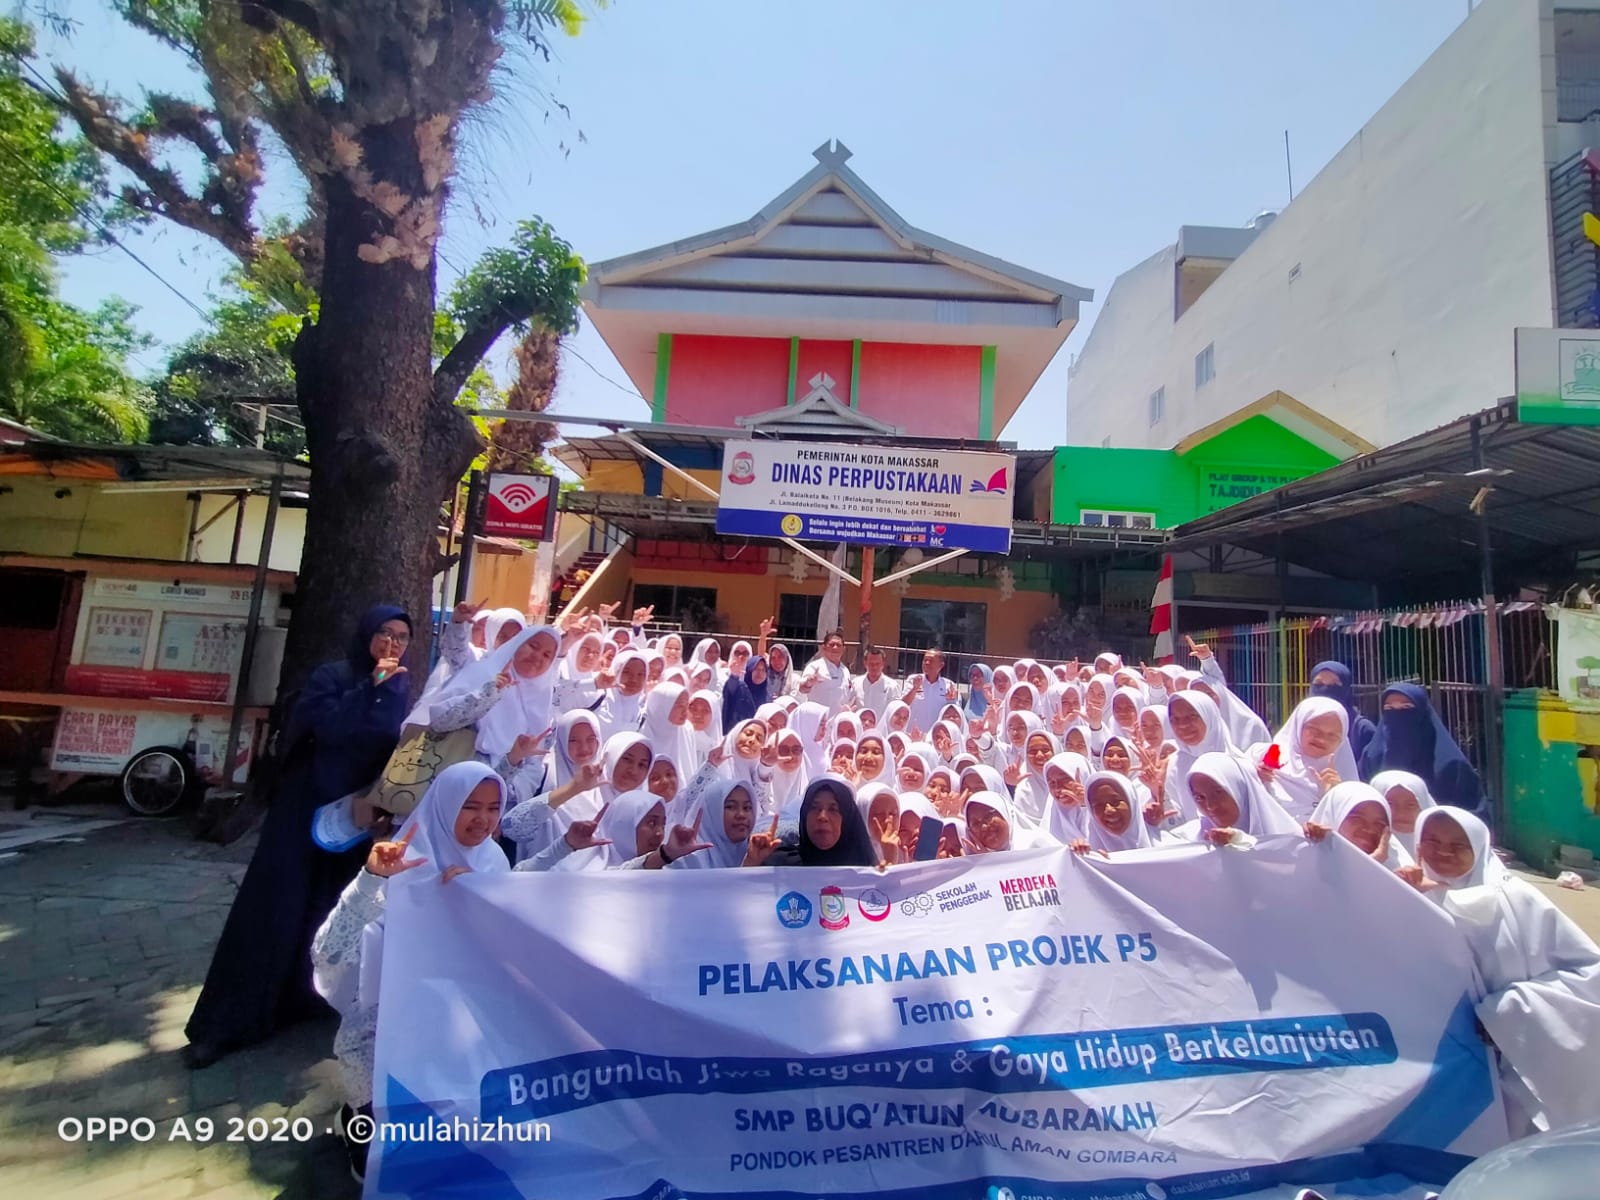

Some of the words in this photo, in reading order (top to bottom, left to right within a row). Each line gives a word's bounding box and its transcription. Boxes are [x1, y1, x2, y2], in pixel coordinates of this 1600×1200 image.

[797, 449, 858, 464] PEMERINTAH
[860, 454, 885, 466] KOTA
[887, 456, 940, 468] MAKASSAR
[771, 462, 823, 486] DINAS
[828, 466, 963, 495] PERPUSTAKAAN
[905, 499, 920, 507] Kota
[809, 527, 835, 536] Bersama
[866, 531, 896, 540] Makassar
[64, 711, 95, 726] CARA
[935, 881, 978, 902] SEKOLAH
[999, 873, 1057, 895] MERDEKA
[939, 889, 993, 913] PENGGERAK
[1003, 888, 1062, 913] BELAJAR
[698, 945, 977, 996] PELAKSANAAN
[984, 935, 1110, 971] PROJEK
[1115, 932, 1159, 962] P5
[891, 994, 974, 1027] Tema
[508, 1054, 684, 1107] Bangunlah
[697, 1059, 772, 1086] Jiwa
[786, 1055, 935, 1083] Raganya
[949, 1049, 975, 1074] &
[988, 1039, 1070, 1086] Gaya
[1074, 1033, 1158, 1077] Hidup
[1164, 1021, 1381, 1064] Berkelanjutan
[734, 1107, 796, 1133] SMP
[730, 1150, 819, 1173] PONDOK
[822, 1137, 946, 1165] PESANTREN
[950, 1130, 1010, 1152] DARUL
[1011, 1139, 1071, 1162] AMAN
[1075, 1148, 1179, 1165] GOMBARA
